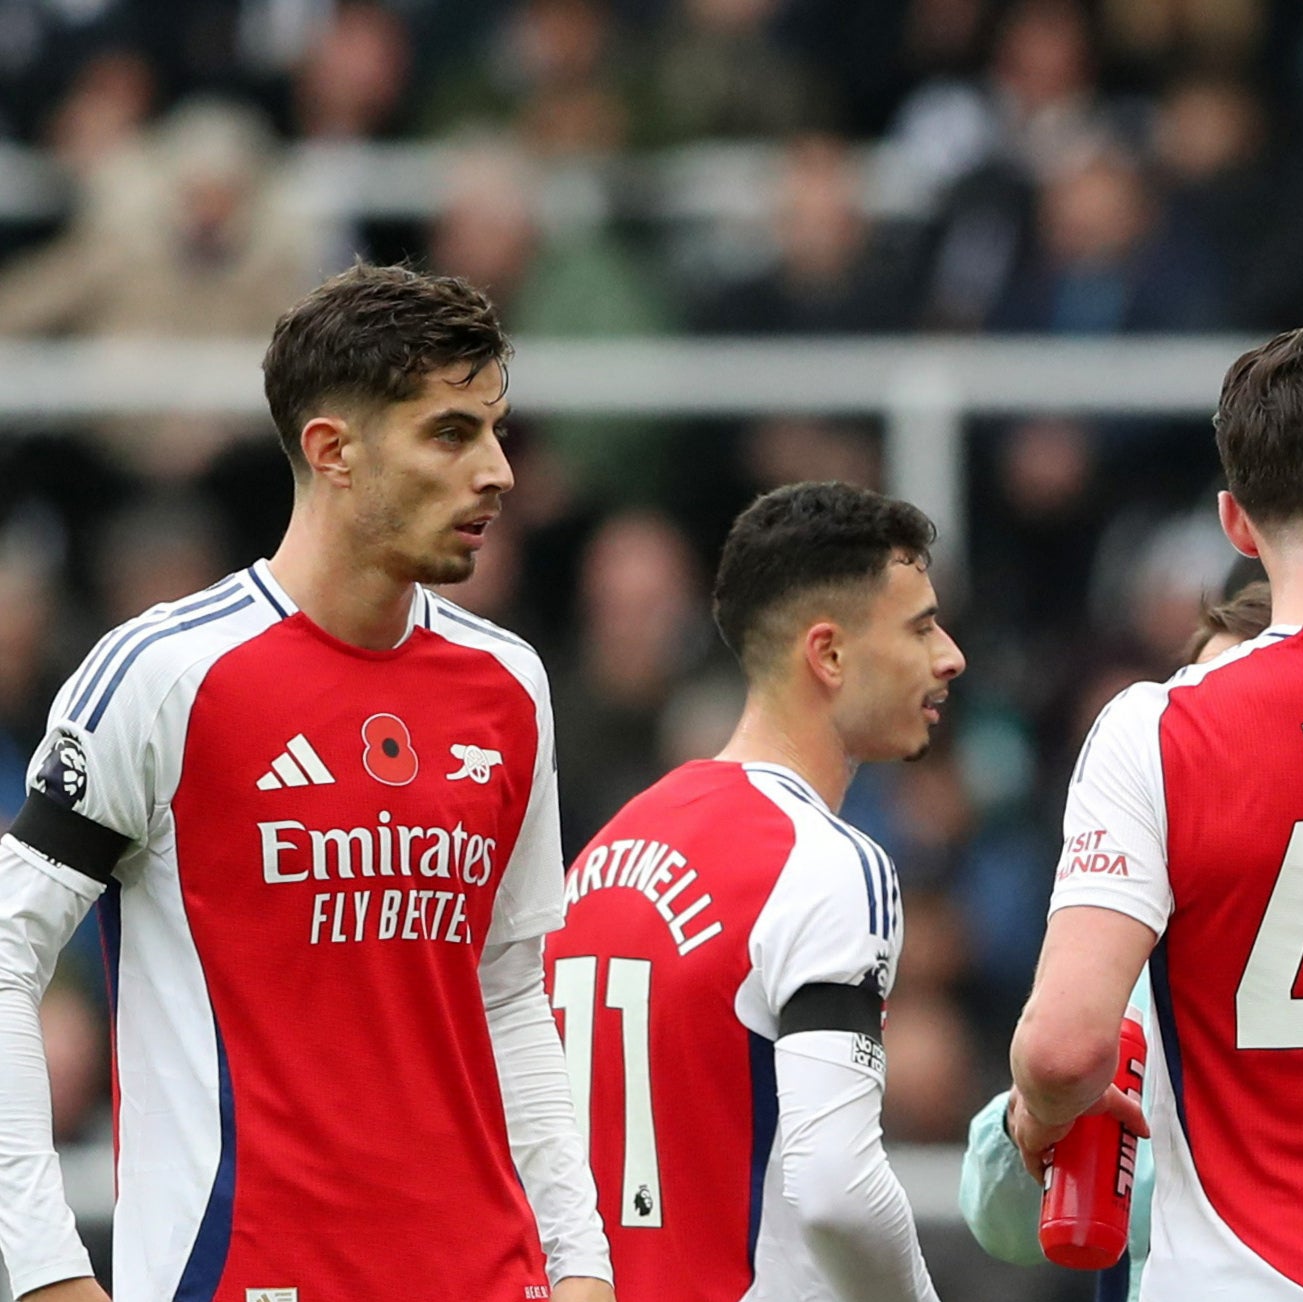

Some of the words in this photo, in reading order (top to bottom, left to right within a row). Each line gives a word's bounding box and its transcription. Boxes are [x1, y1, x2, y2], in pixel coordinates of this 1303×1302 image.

[256, 810, 496, 887] Emirates
[310, 890, 371, 945] FLY
[563, 839, 724, 957] ARTINELLI
[551, 955, 663, 1228] 11
